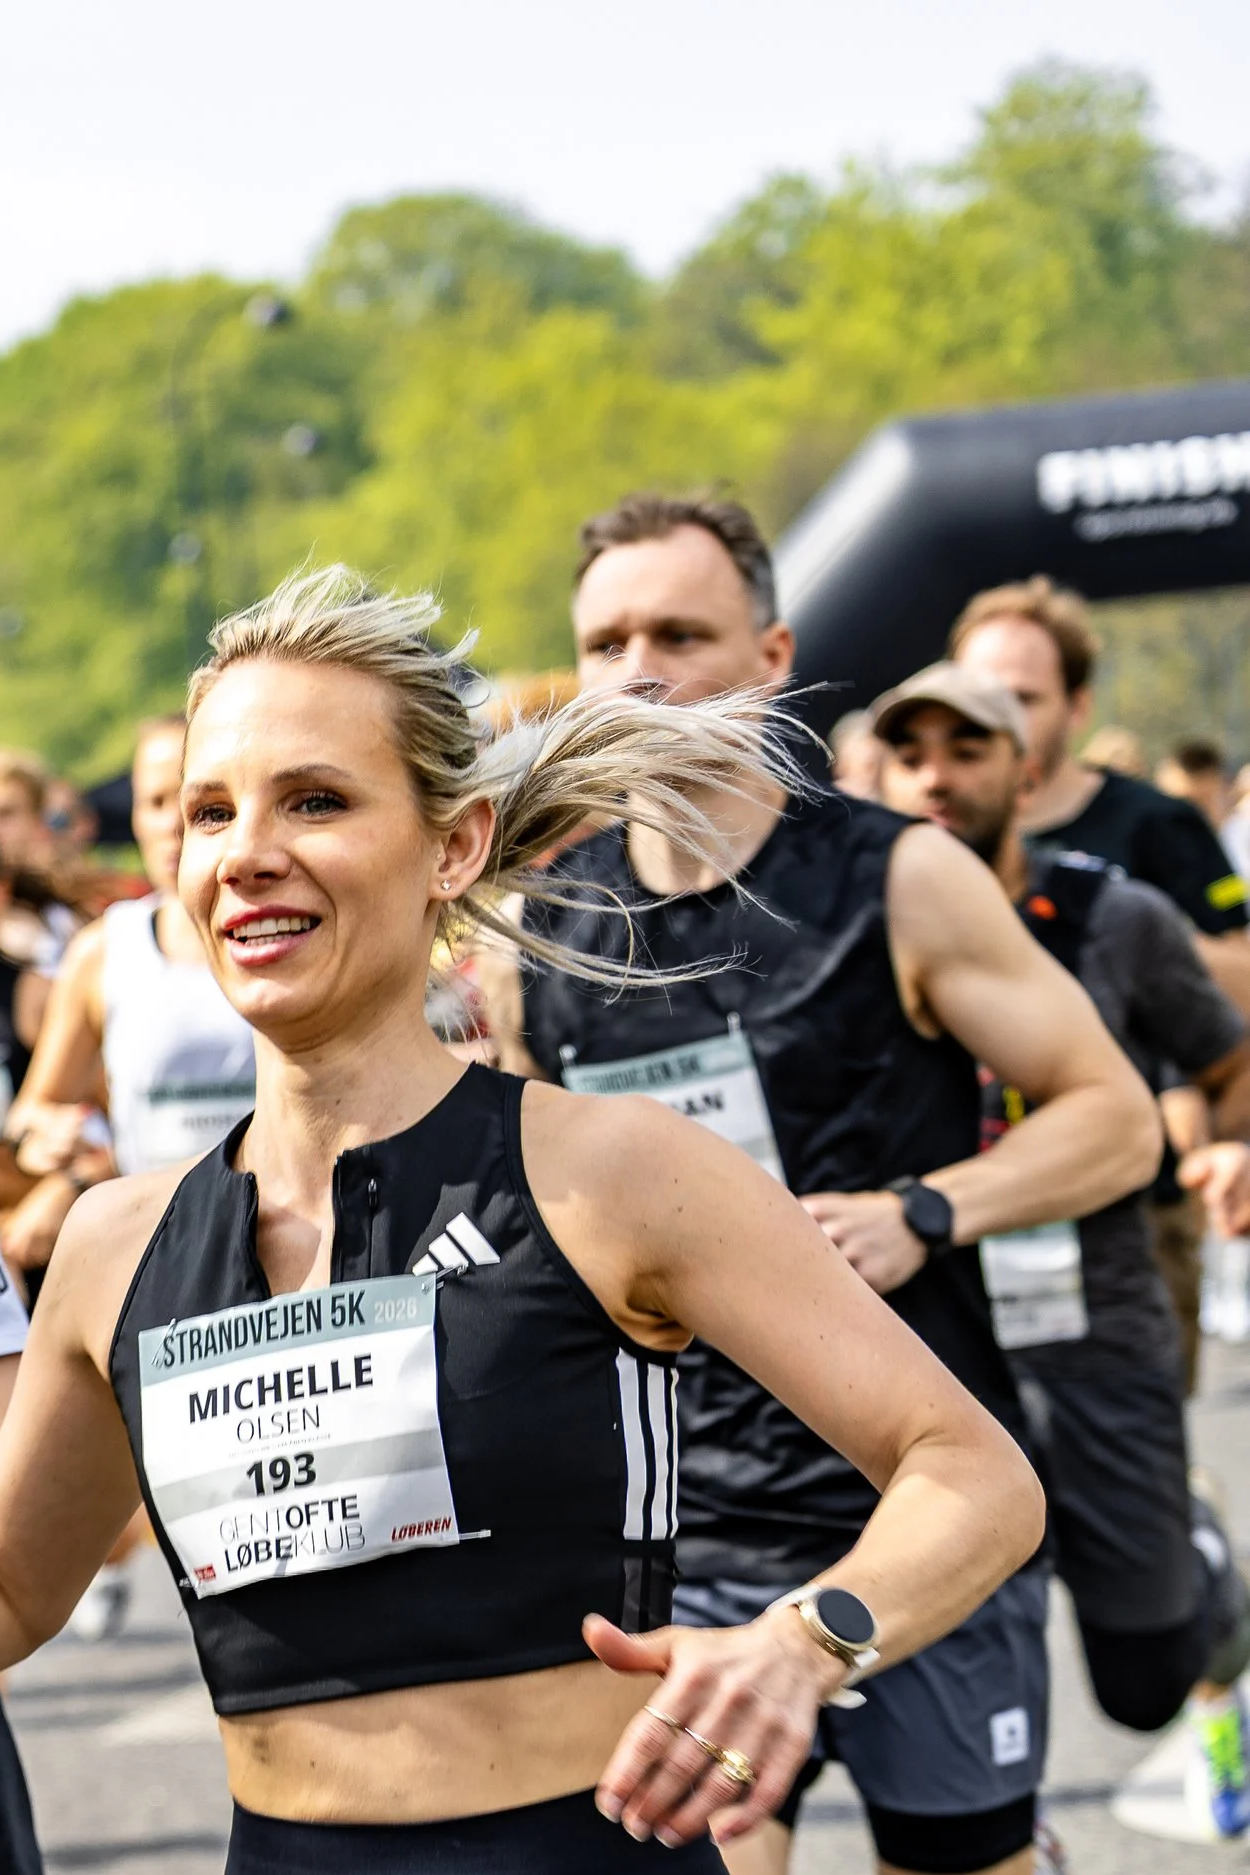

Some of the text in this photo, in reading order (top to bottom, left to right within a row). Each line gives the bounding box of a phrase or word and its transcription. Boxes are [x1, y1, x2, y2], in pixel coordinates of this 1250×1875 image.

[162, 1299, 323, 1368] STRANDVEJEN
[331, 1289, 366, 1328] 5K
[188, 1354, 374, 1425] MICHELLE
[236, 1405, 320, 1444] OLSEN
[246, 1450, 317, 1497] 193
[219, 1494, 361, 1546] GENTOFTE
[223, 1521, 367, 1574] LØBEKLUB
